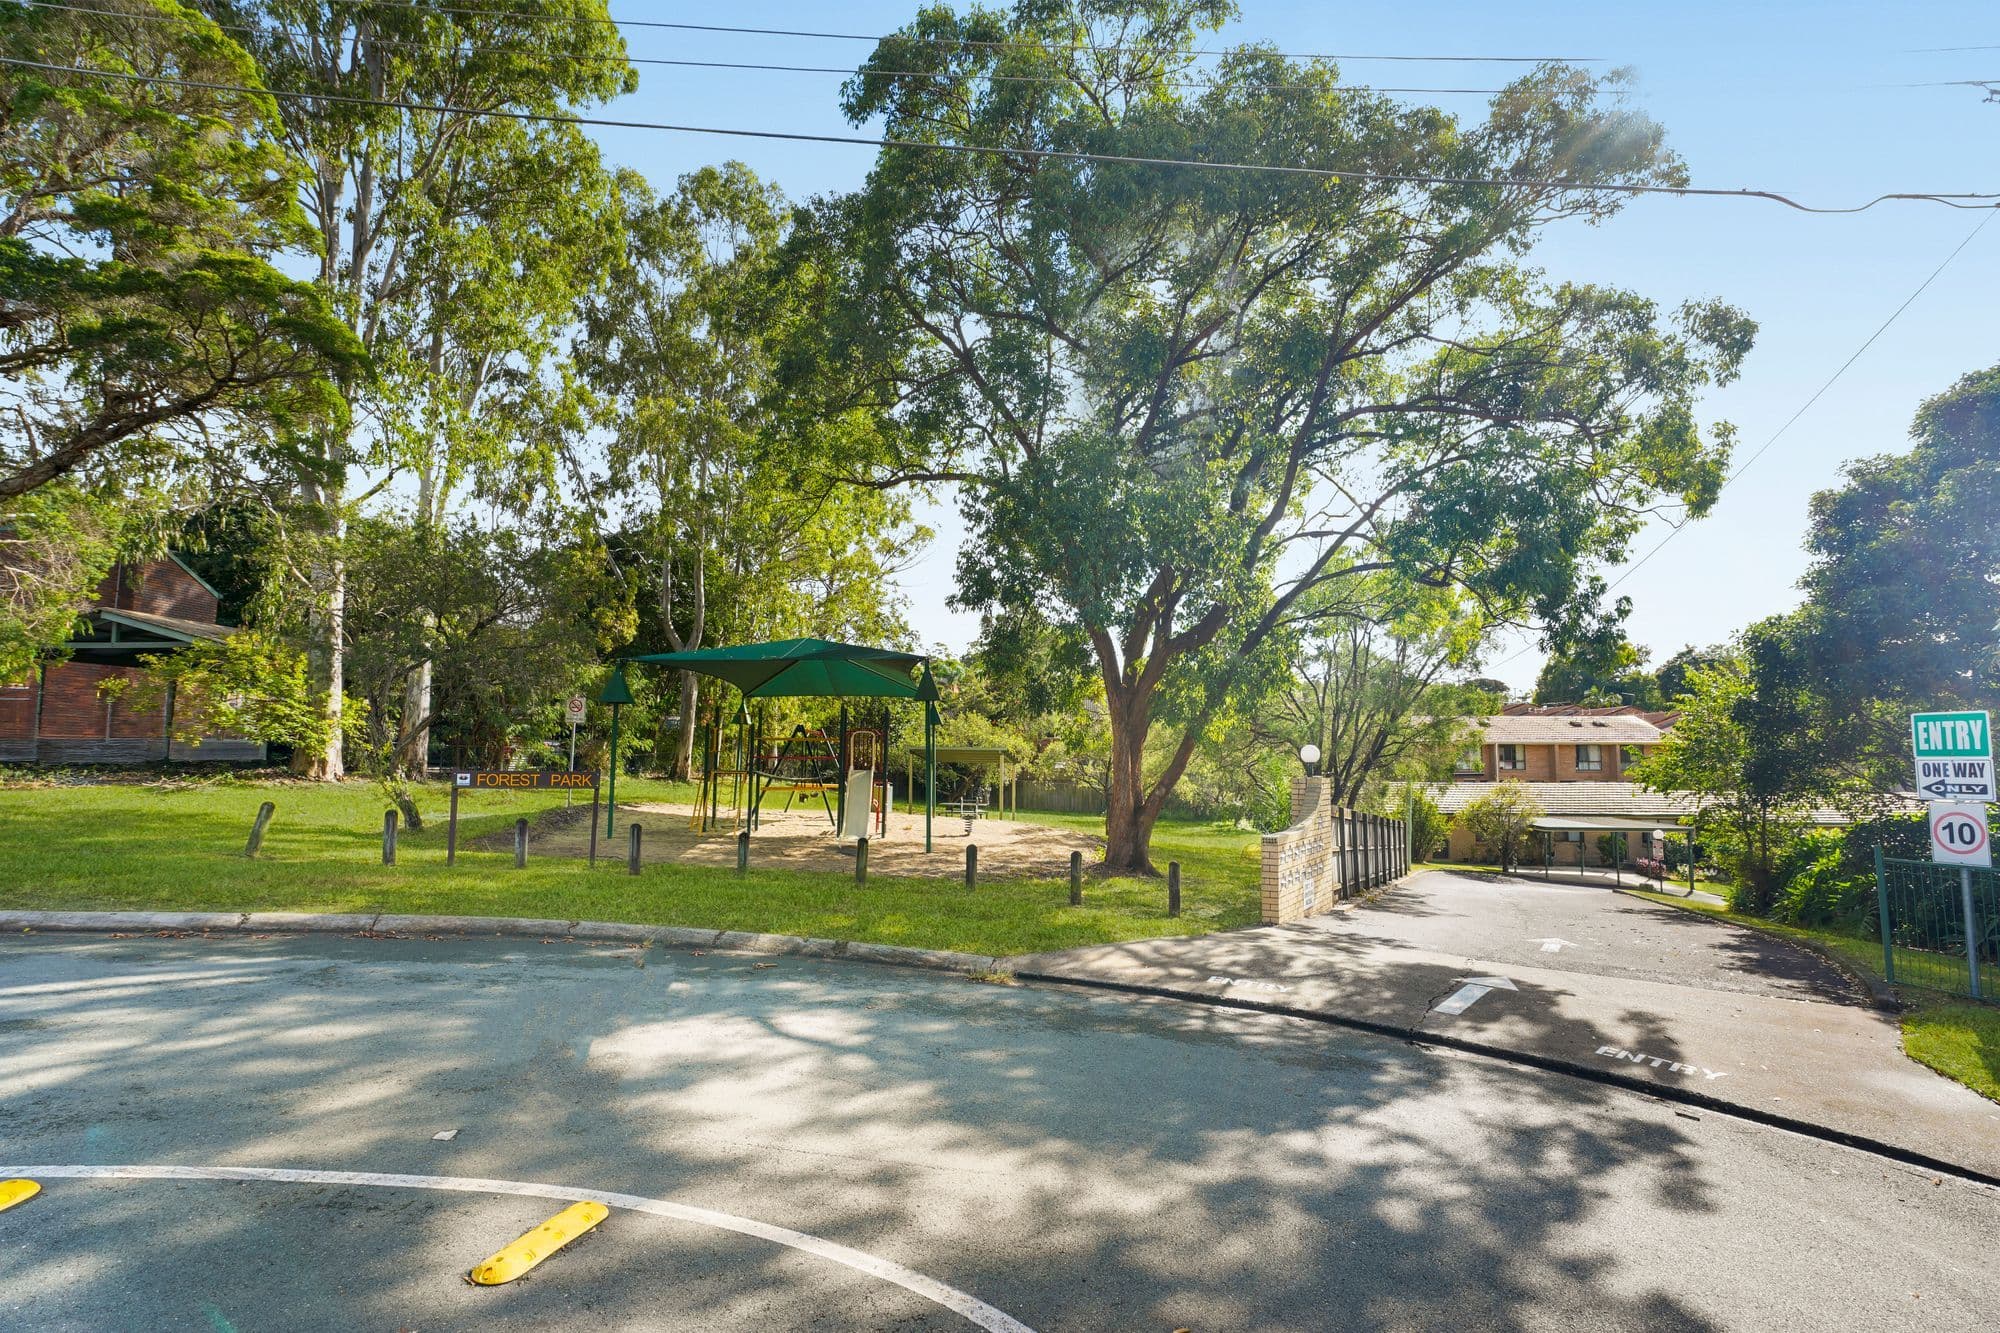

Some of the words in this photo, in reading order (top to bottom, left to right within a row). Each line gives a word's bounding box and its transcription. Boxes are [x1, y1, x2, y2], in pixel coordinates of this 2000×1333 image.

[1917, 719, 1983, 751] ENTRY
[477, 773, 540, 787] FOREST
[551, 774, 592, 787] PARK
[1922, 762, 1950, 778] ONE
[1952, 762, 1985, 778] WAY
[1931, 784, 1984, 794] ONLY
[1942, 821, 1976, 845] 10
[1595, 1046, 1728, 1080] ENTRY
